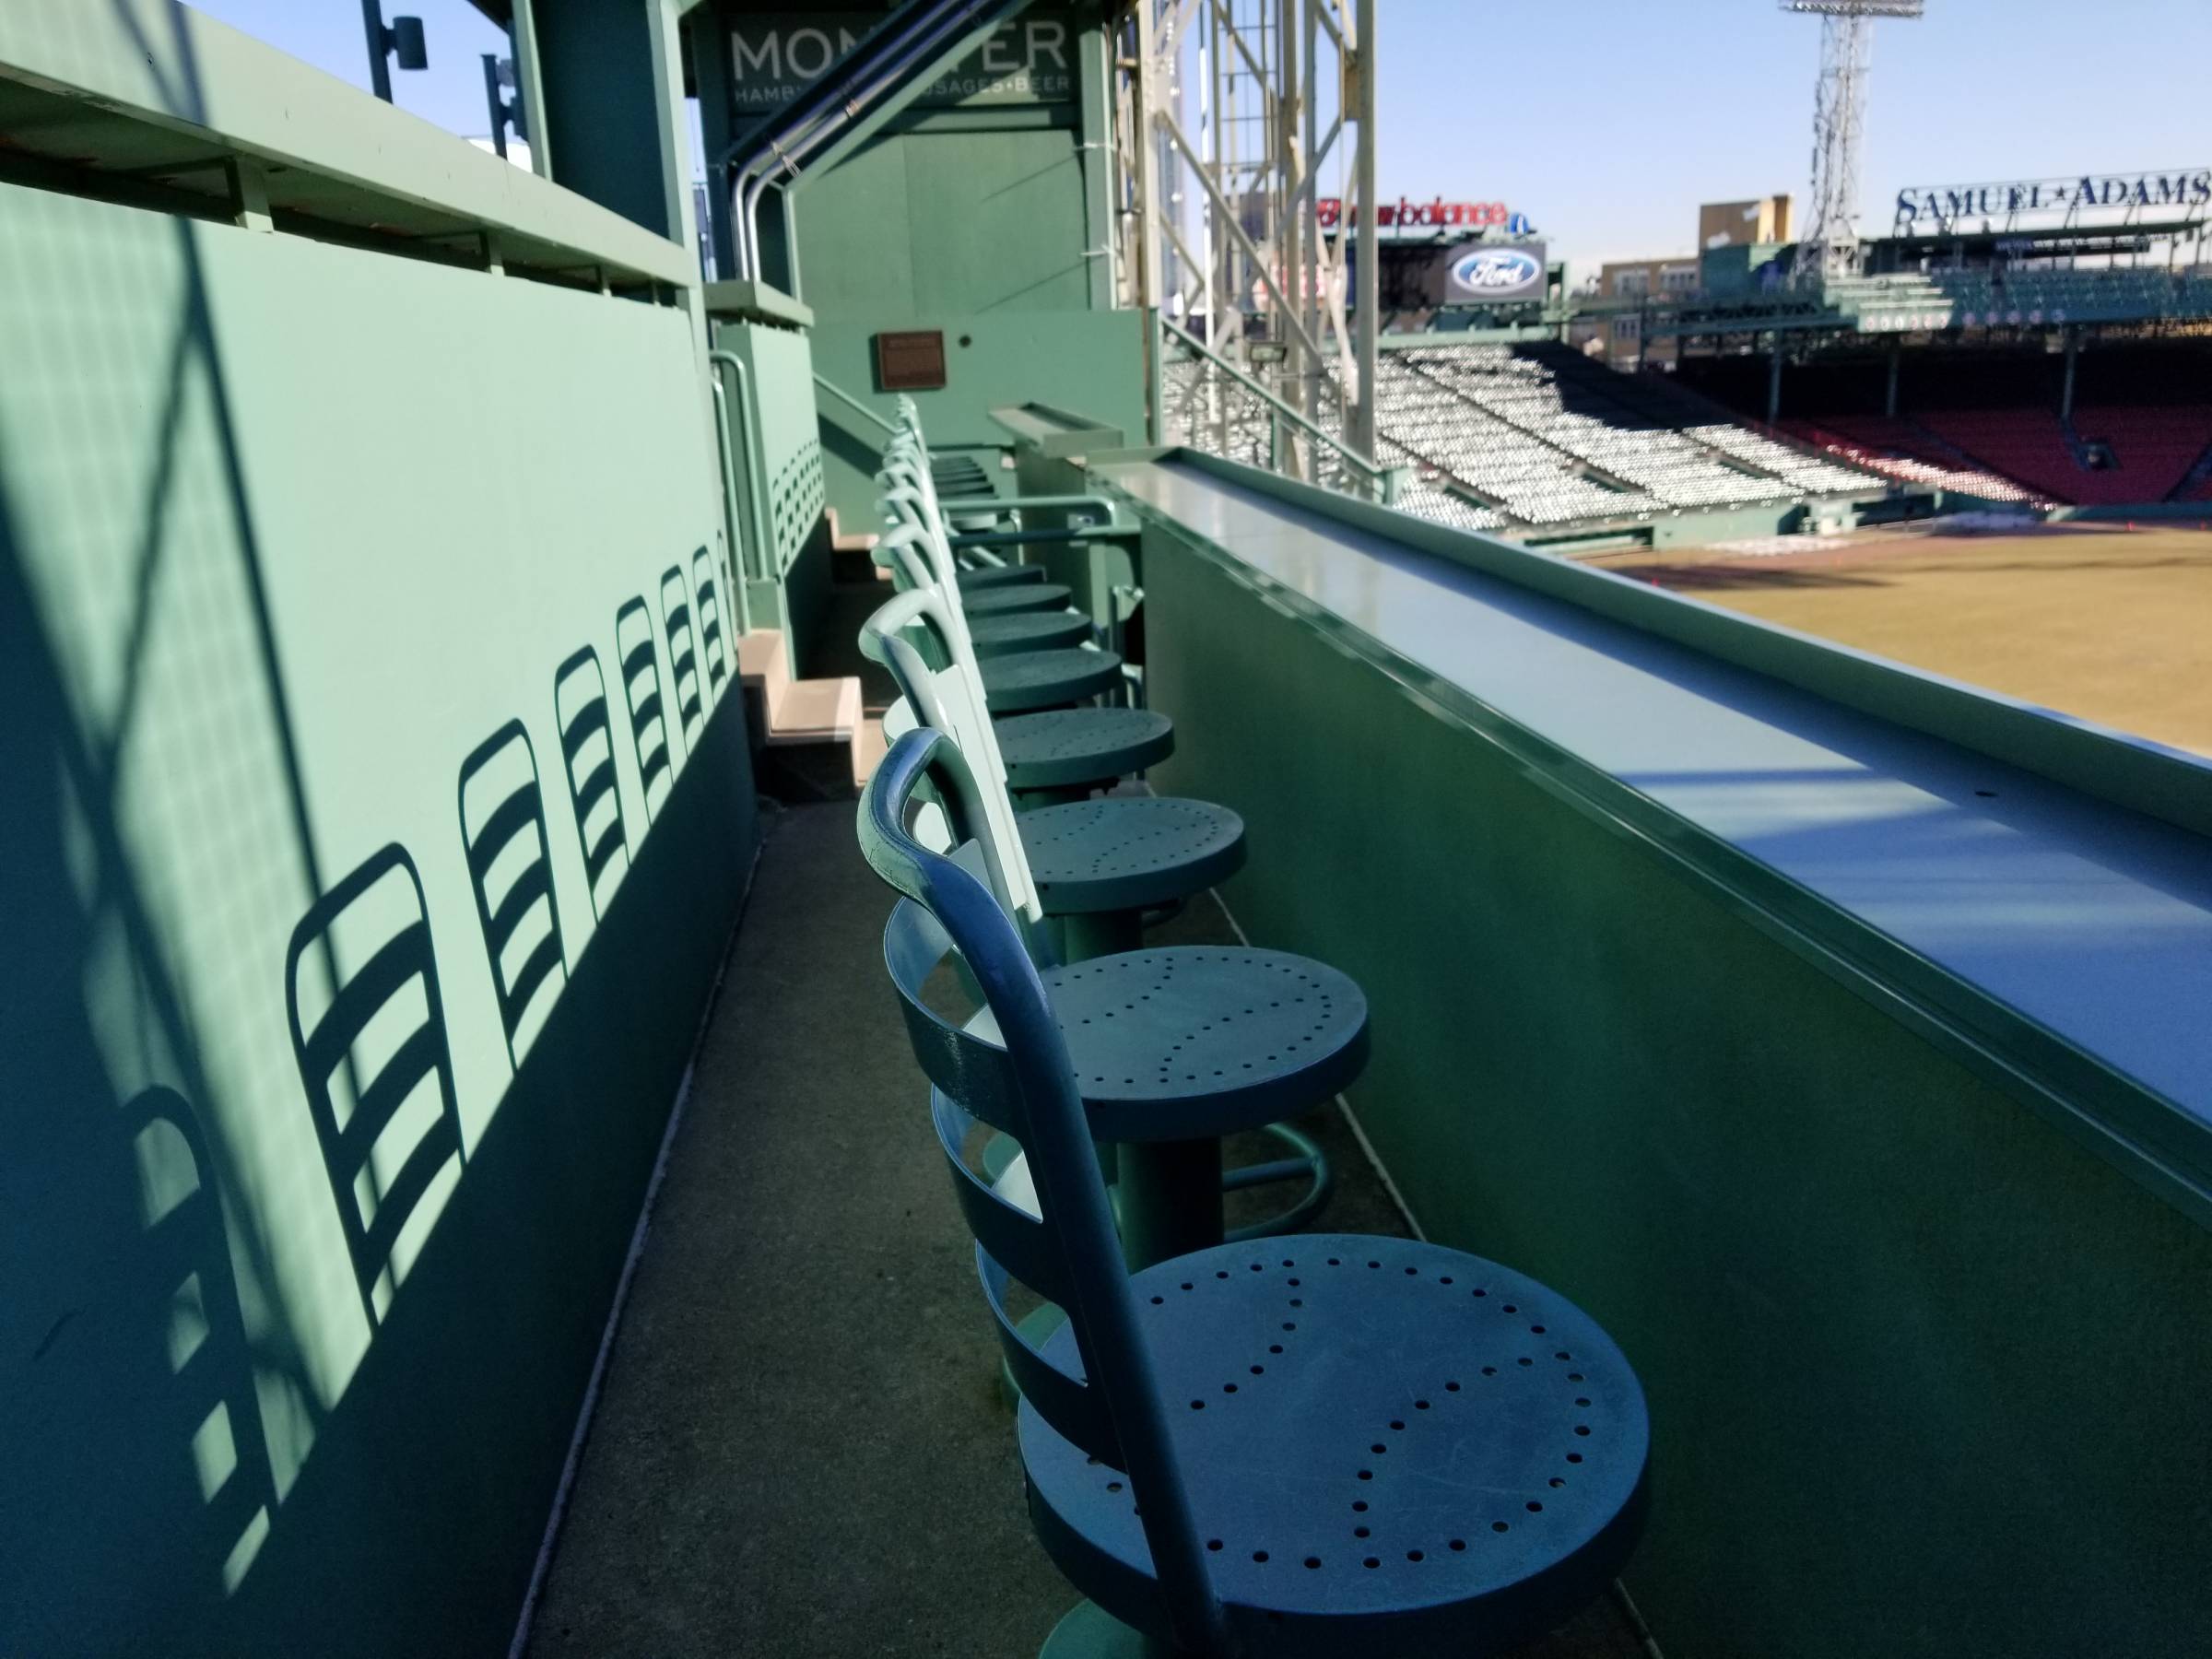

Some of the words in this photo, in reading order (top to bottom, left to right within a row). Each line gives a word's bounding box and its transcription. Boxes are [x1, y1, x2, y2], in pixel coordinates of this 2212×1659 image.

[731, 20, 1067, 80] MOER
[1398, 195, 1508, 227] balance
[1896, 184, 2048, 223] SAMUEL
[2076, 170, 2211, 207] ADAMS
[1470, 256, 1525, 287] Ford
